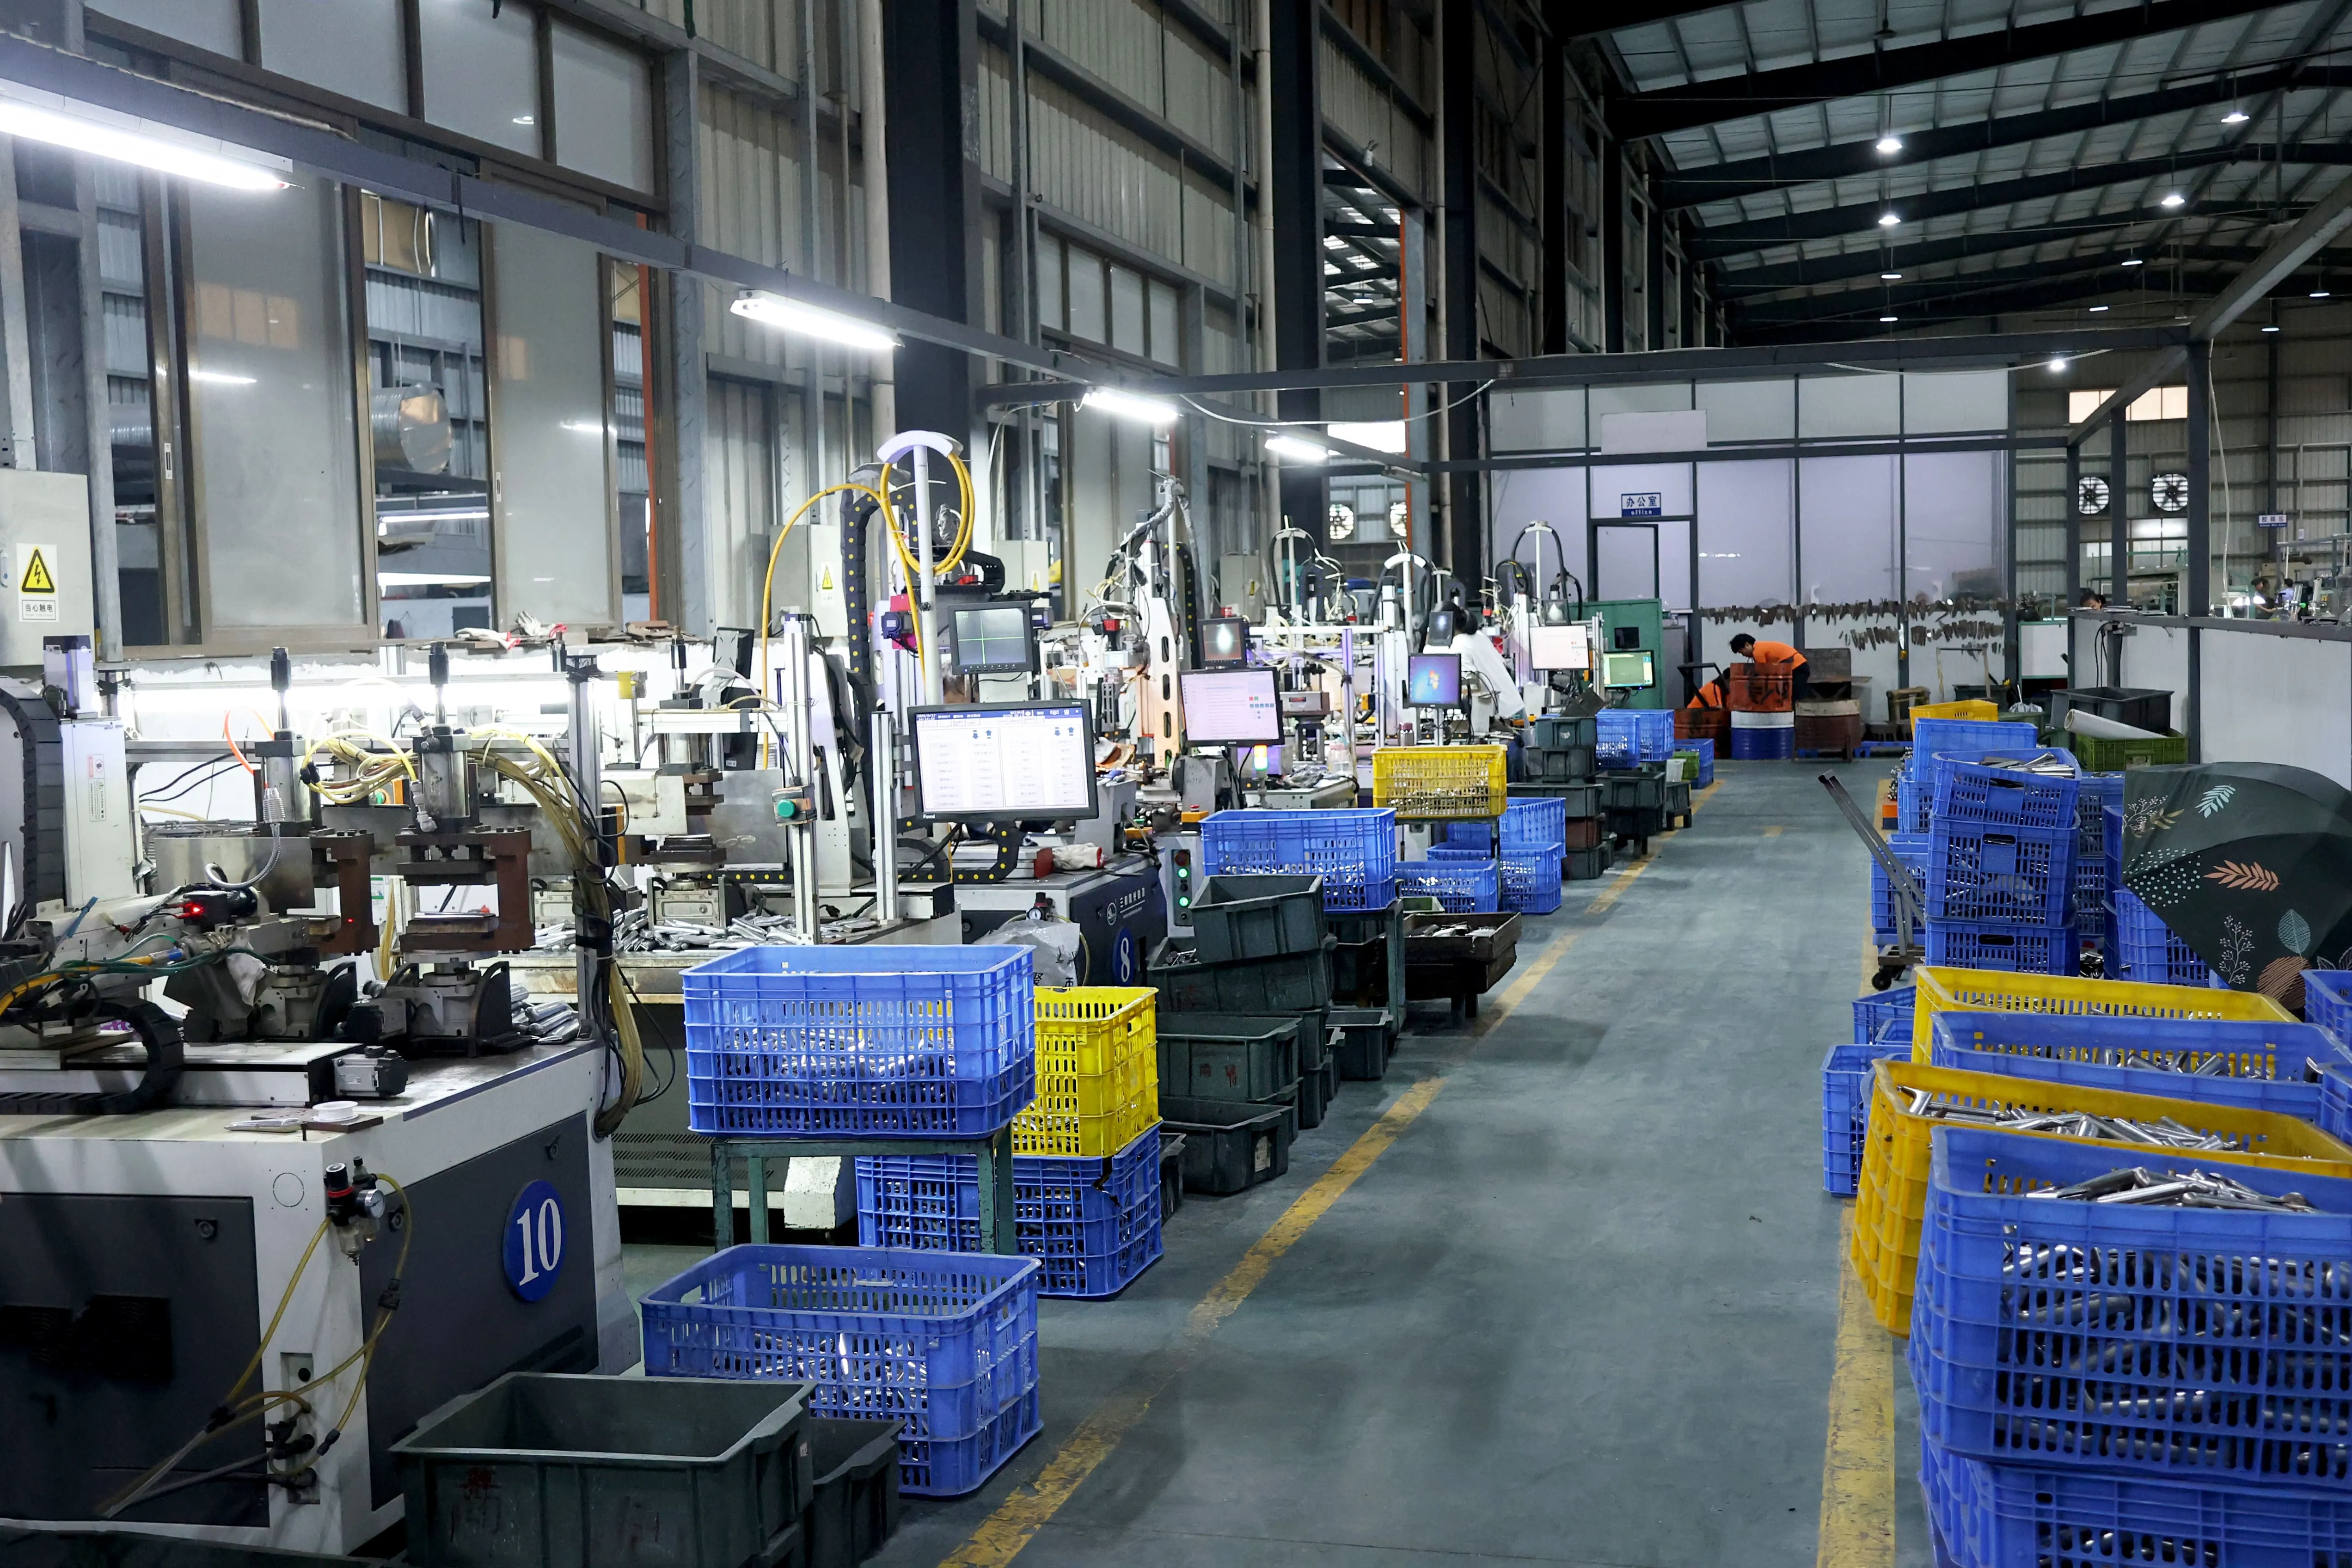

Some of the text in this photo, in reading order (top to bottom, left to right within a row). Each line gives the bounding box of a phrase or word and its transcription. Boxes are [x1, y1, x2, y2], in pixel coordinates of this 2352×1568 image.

[1626, 496, 1657, 507] 办公室
[26, 603, 53, 612] 当心触电
[1121, 937, 1130, 982] 8
[517, 1198, 561, 1286] 10
